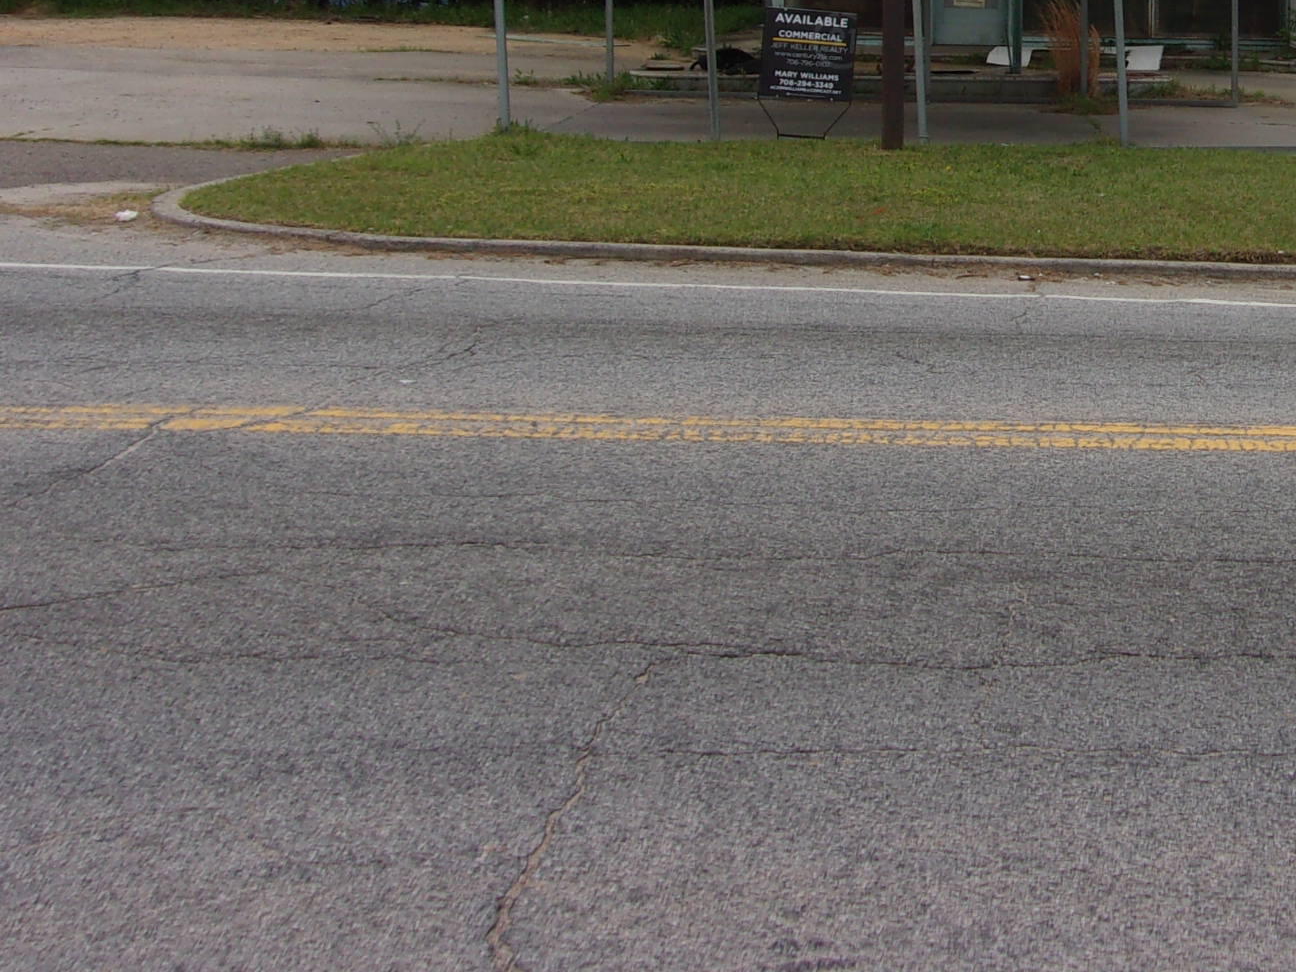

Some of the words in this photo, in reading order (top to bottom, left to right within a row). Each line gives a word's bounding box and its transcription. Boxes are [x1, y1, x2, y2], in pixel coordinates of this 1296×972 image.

[775, 13, 849, 28] AVAILABLE
[778, 29, 843, 42] COMMERCIAL
[774, 70, 798, 79] MARY
[800, 71, 839, 82] WILLIAMS
